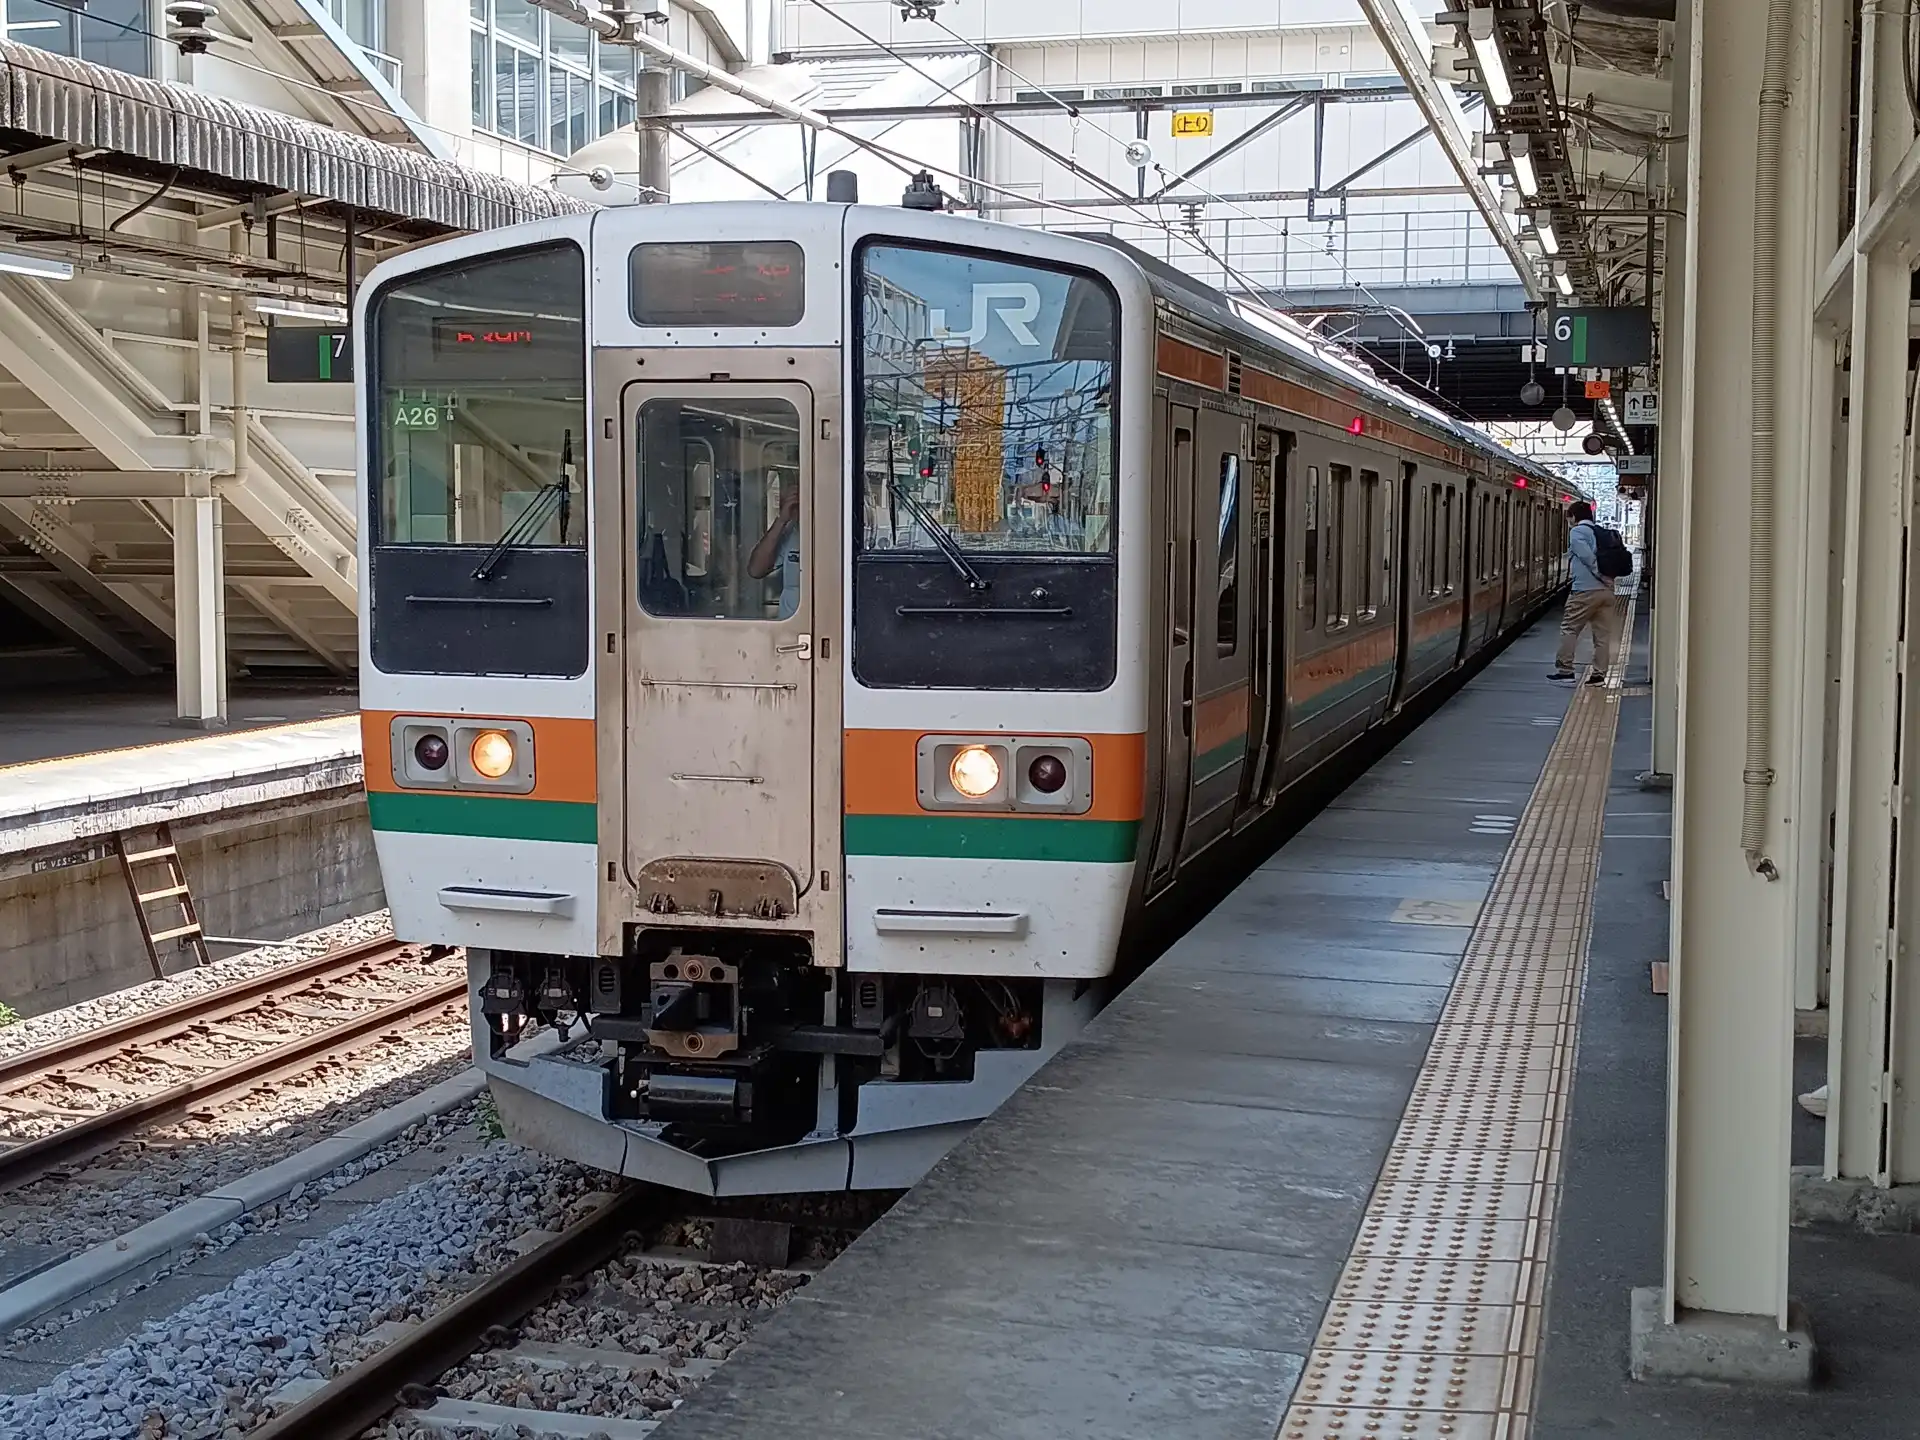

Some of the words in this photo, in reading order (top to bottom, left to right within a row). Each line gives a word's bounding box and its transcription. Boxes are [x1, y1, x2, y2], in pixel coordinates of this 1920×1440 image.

[929, 283, 1041, 347] JR
[1554, 316, 1571, 341] 6
[331, 335, 346, 358] 7
[395, 407, 437, 425] A26
